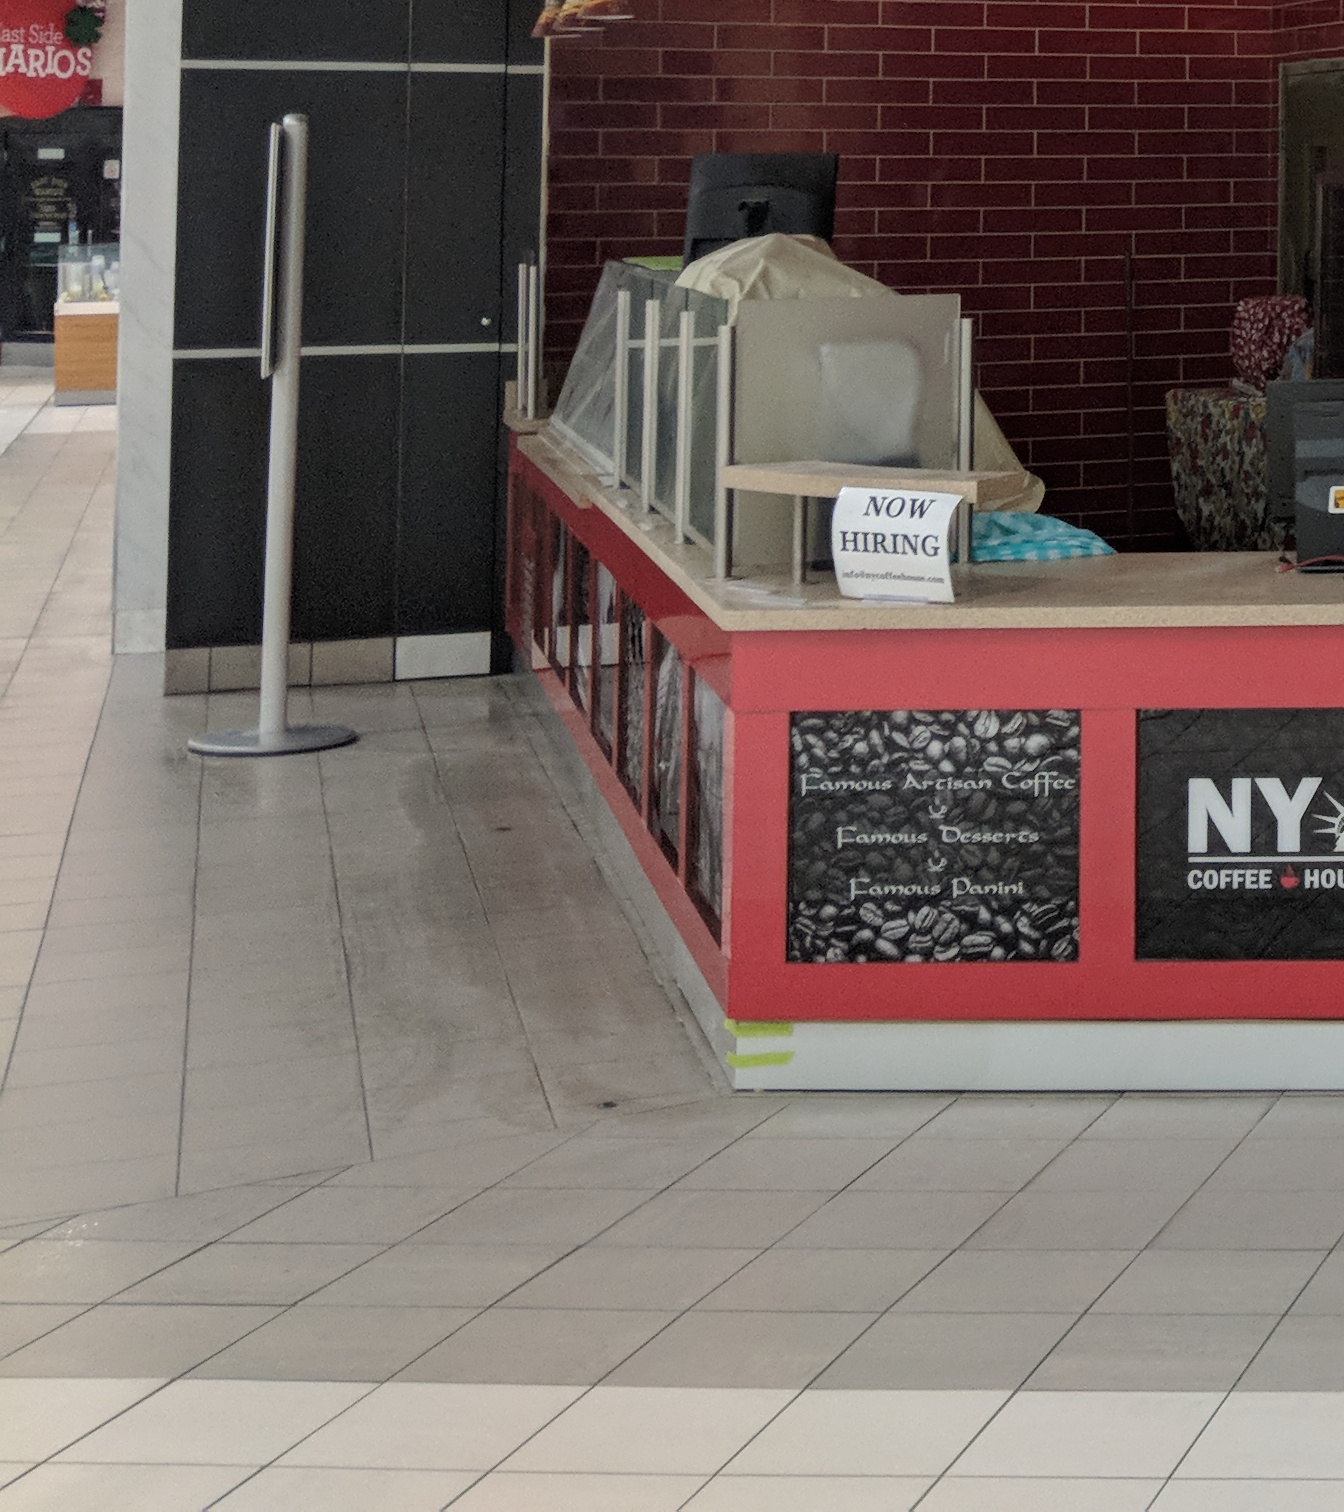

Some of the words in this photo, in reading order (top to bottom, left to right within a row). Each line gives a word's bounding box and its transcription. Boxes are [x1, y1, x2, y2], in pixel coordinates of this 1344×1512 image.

[0, 25, 26, 43] ast
[28, 22, 64, 44] Side
[862, 495, 938, 519] NOW
[839, 530, 941, 558] HIRING
[800, 773, 893, 797] Famous
[902, 772, 993, 792] Artisan
[1001, 770, 1077, 798] Coffee
[1187, 776, 1323, 854] NY
[835, 825, 929, 849] Famous
[938, 824, 1041, 845] Desserts
[848, 876, 942, 901] Famous
[950, 876, 1025, 899] Panini
[1187, 868, 1273, 890] COFFEE
